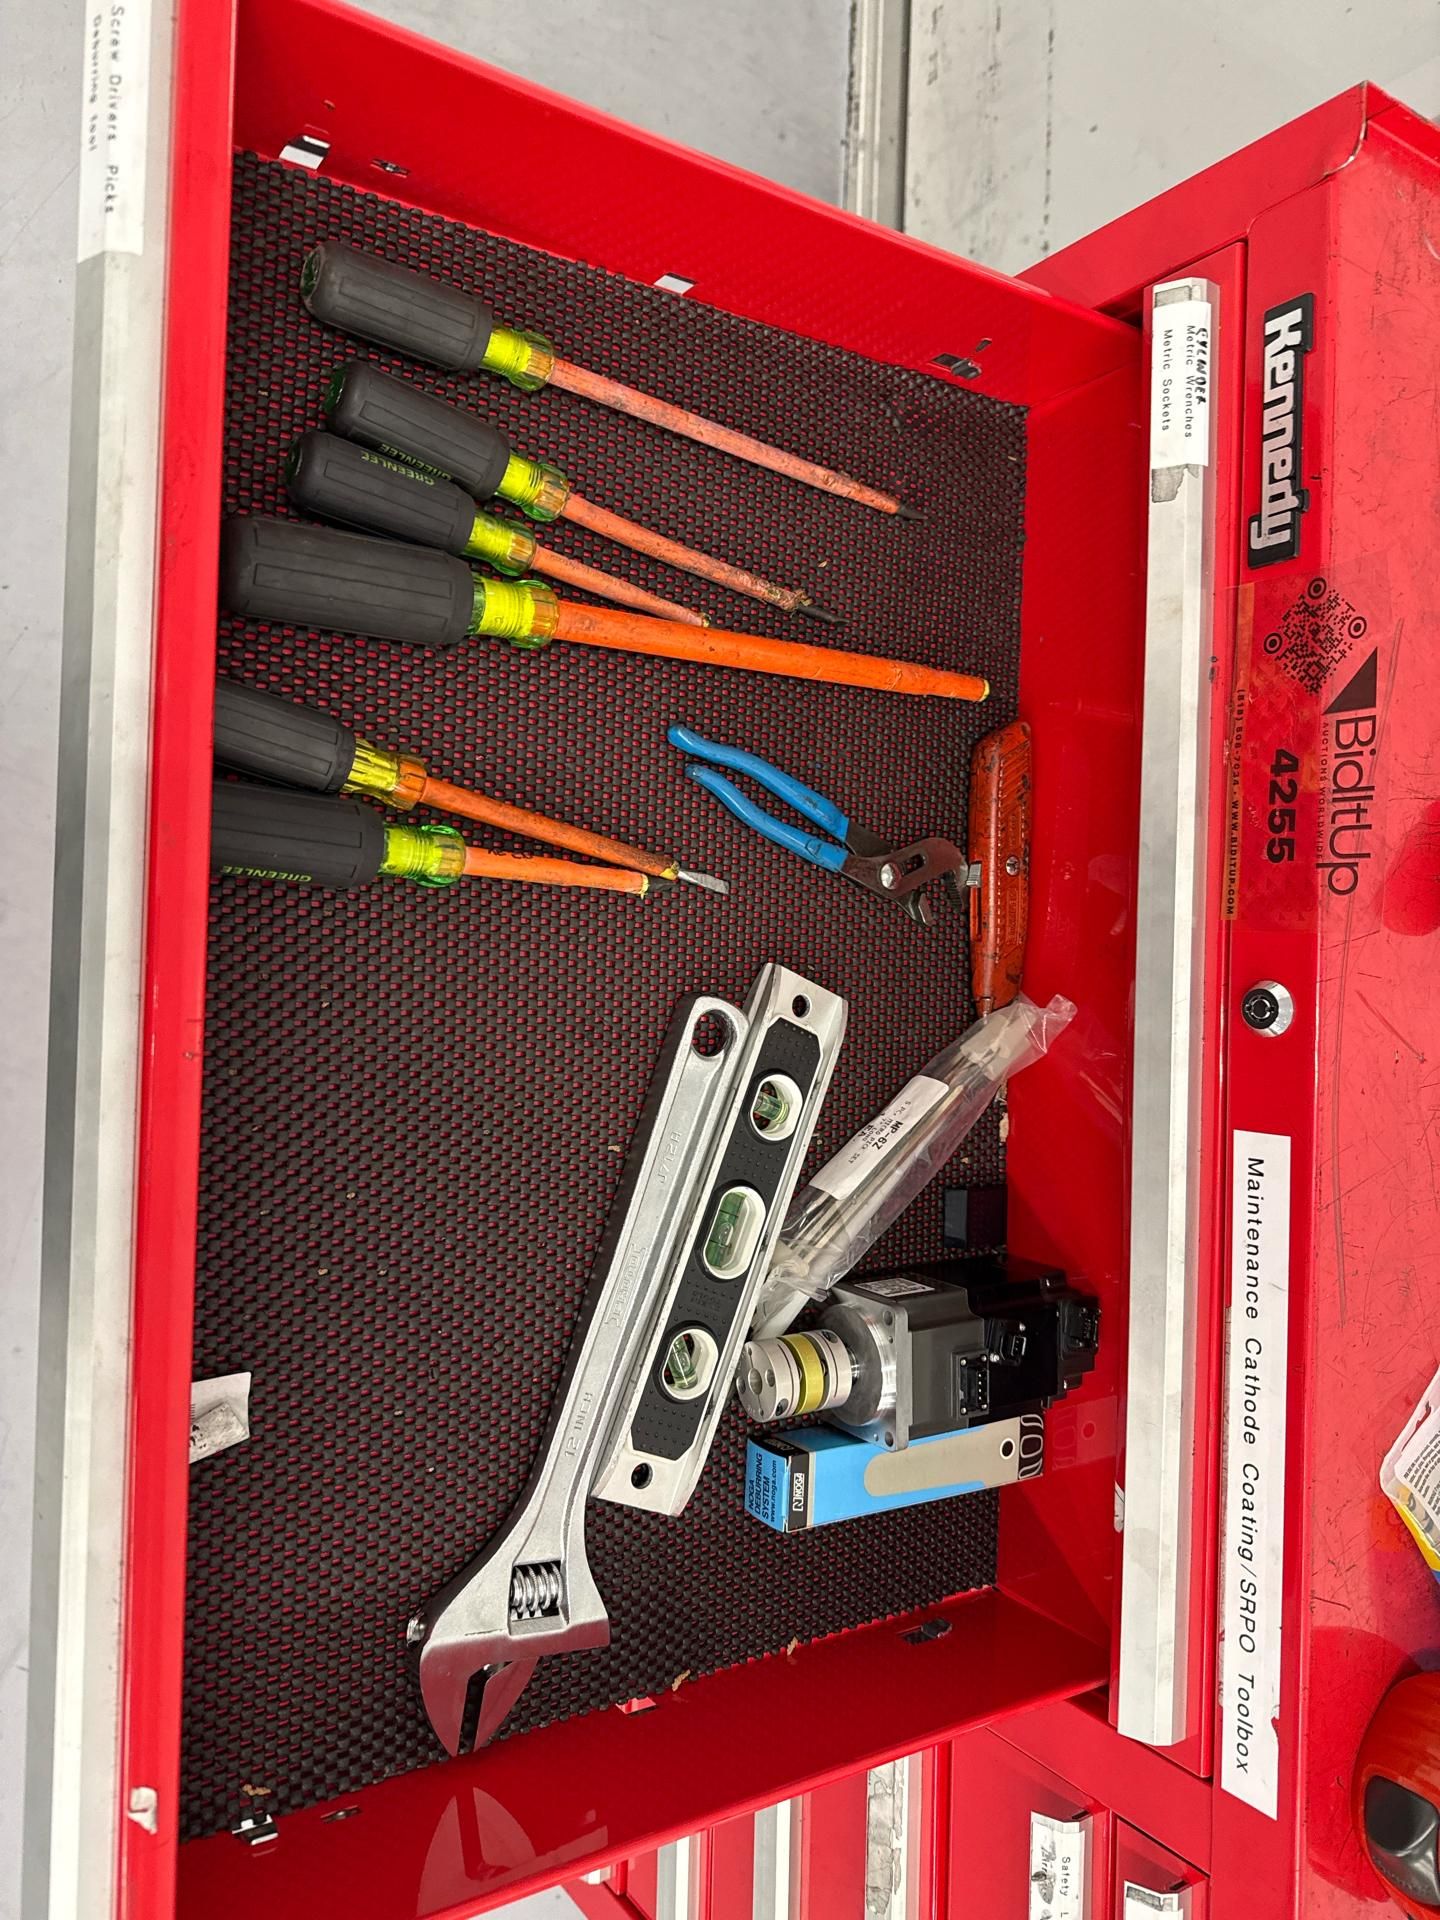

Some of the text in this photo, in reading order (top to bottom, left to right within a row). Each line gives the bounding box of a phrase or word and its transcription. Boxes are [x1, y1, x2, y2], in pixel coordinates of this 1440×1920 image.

[105, 4, 125, 213] Screw Drivers Picks
[1161, 329, 1173, 431] Metric Sockets
[1184, 325, 1196, 438] Metric Wrenches
[1250, 307, 1303, 550] Kennedy
[361, 452, 435, 486] GREENLEE
[380, 443, 452, 481] GREENLEE
[1266, 748, 1300, 864] 4255
[1316, 722, 1330, 860] AUCTIONS WORLDWIDE
[222, 866, 313, 882] GREENLEE
[1226, 799, 1241, 915] WWW.BIDITUP.COM
[574, 1392, 594, 1432] INCH
[755, 1453, 763, 1515] DEBURRING
[762, 1476, 770, 1519] SYSTEM
[1236, 1157, 1265, 1775] Maintenance Cathode Coating/SRPO Toolbox
[1060, 1856, 1071, 1896] Safety
